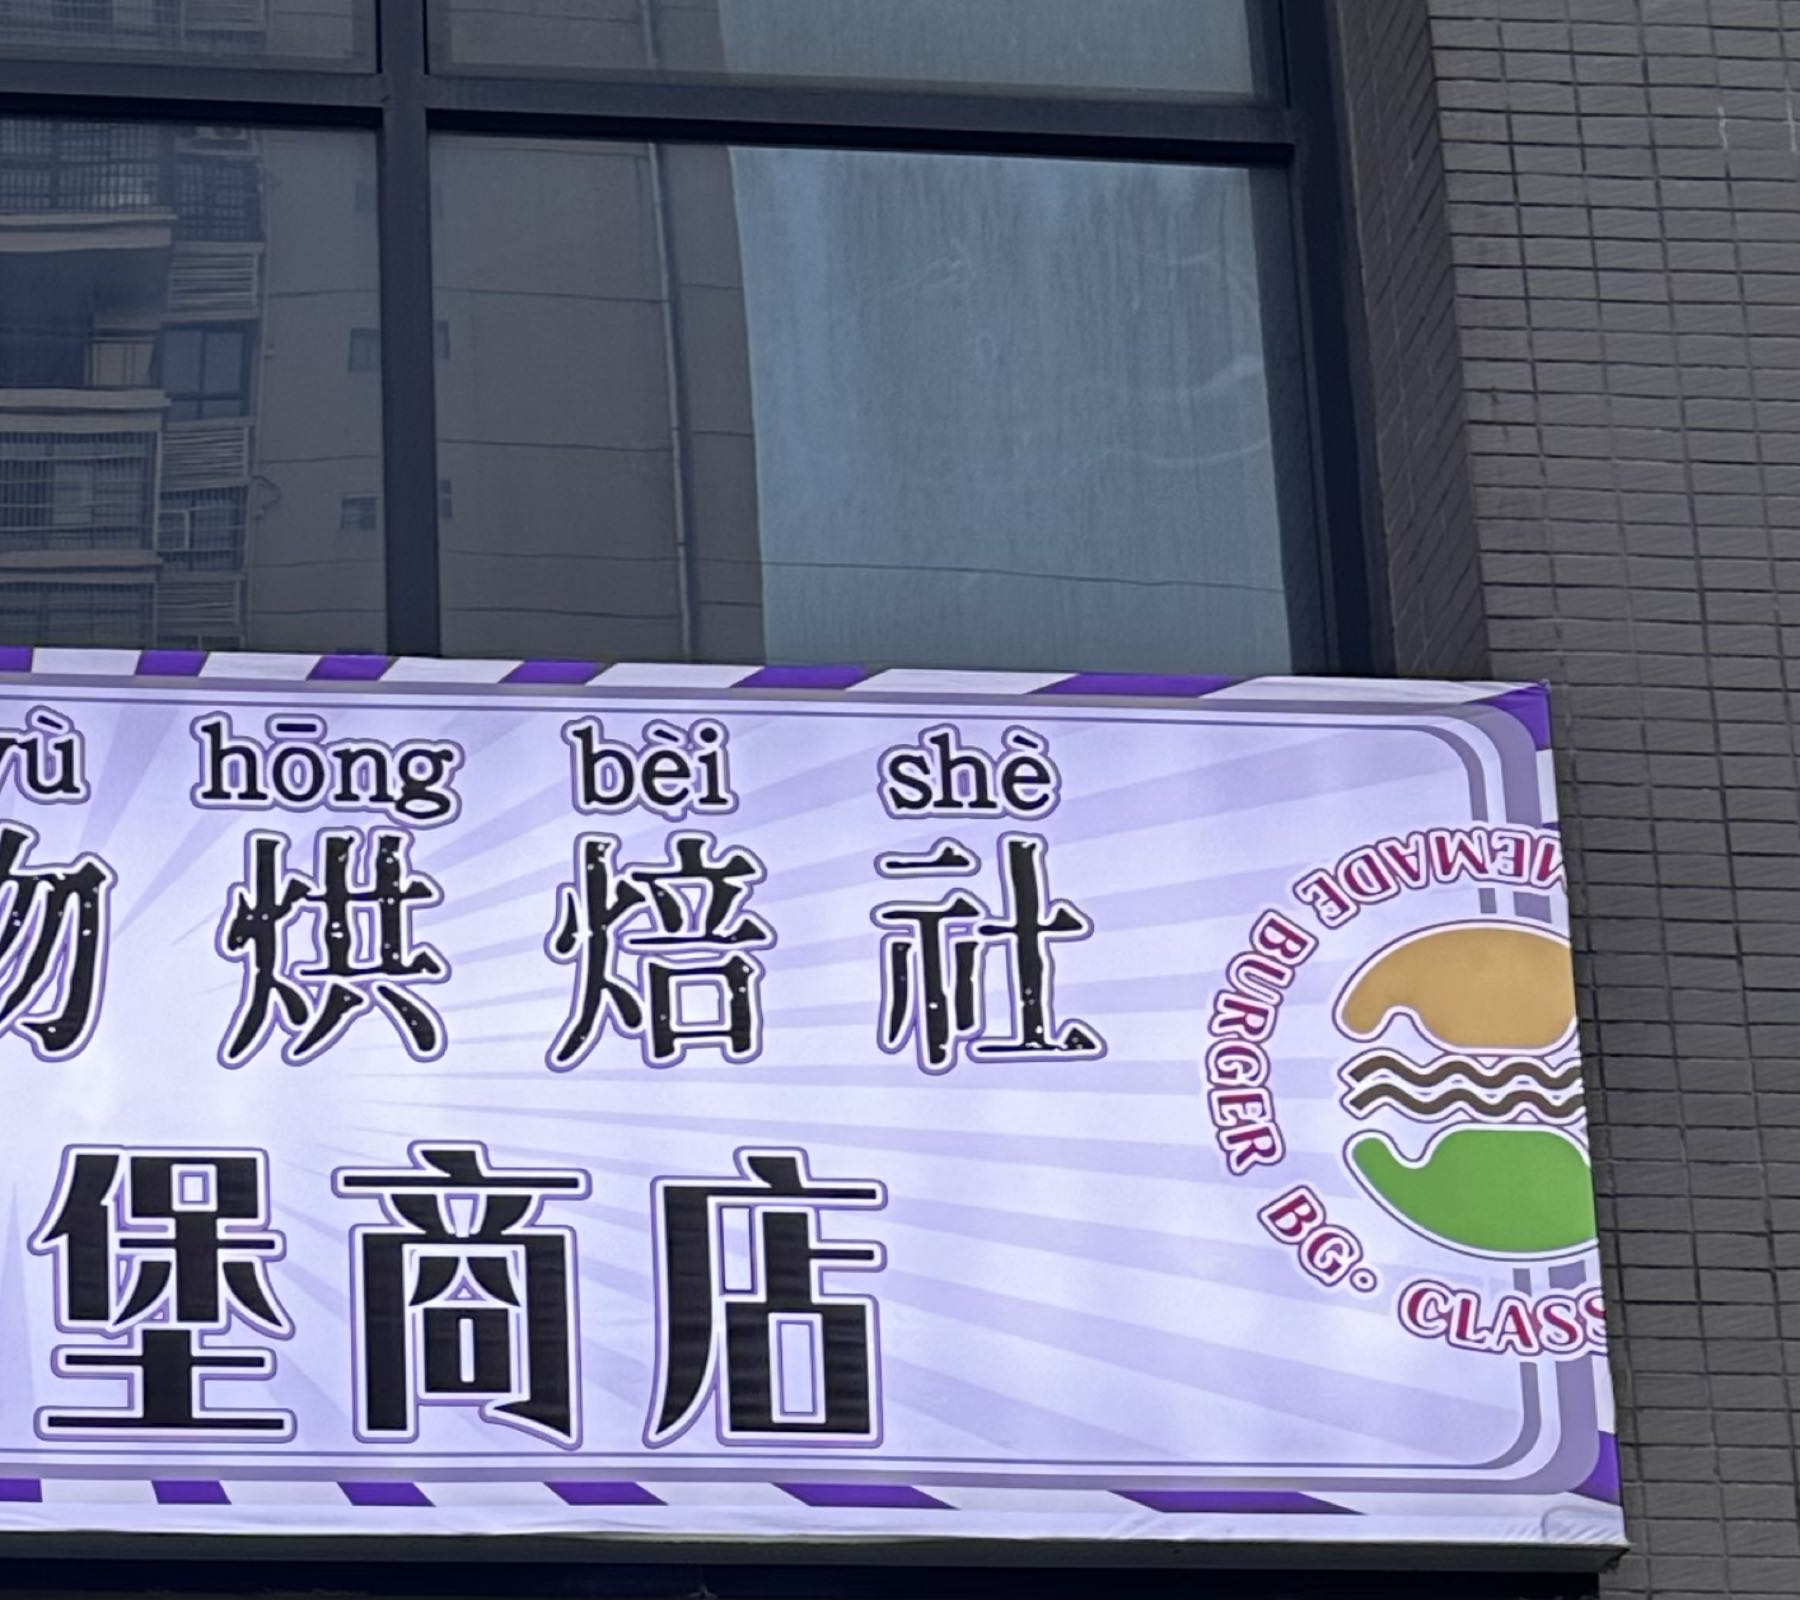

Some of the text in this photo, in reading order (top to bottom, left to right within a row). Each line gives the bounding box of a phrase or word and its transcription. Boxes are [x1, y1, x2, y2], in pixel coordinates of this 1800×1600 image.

[200, 720, 455, 820] hōng
[571, 725, 729, 807] bèi
[888, 731, 1052, 811] shè
[1210, 916, 1311, 1169] BURGER
